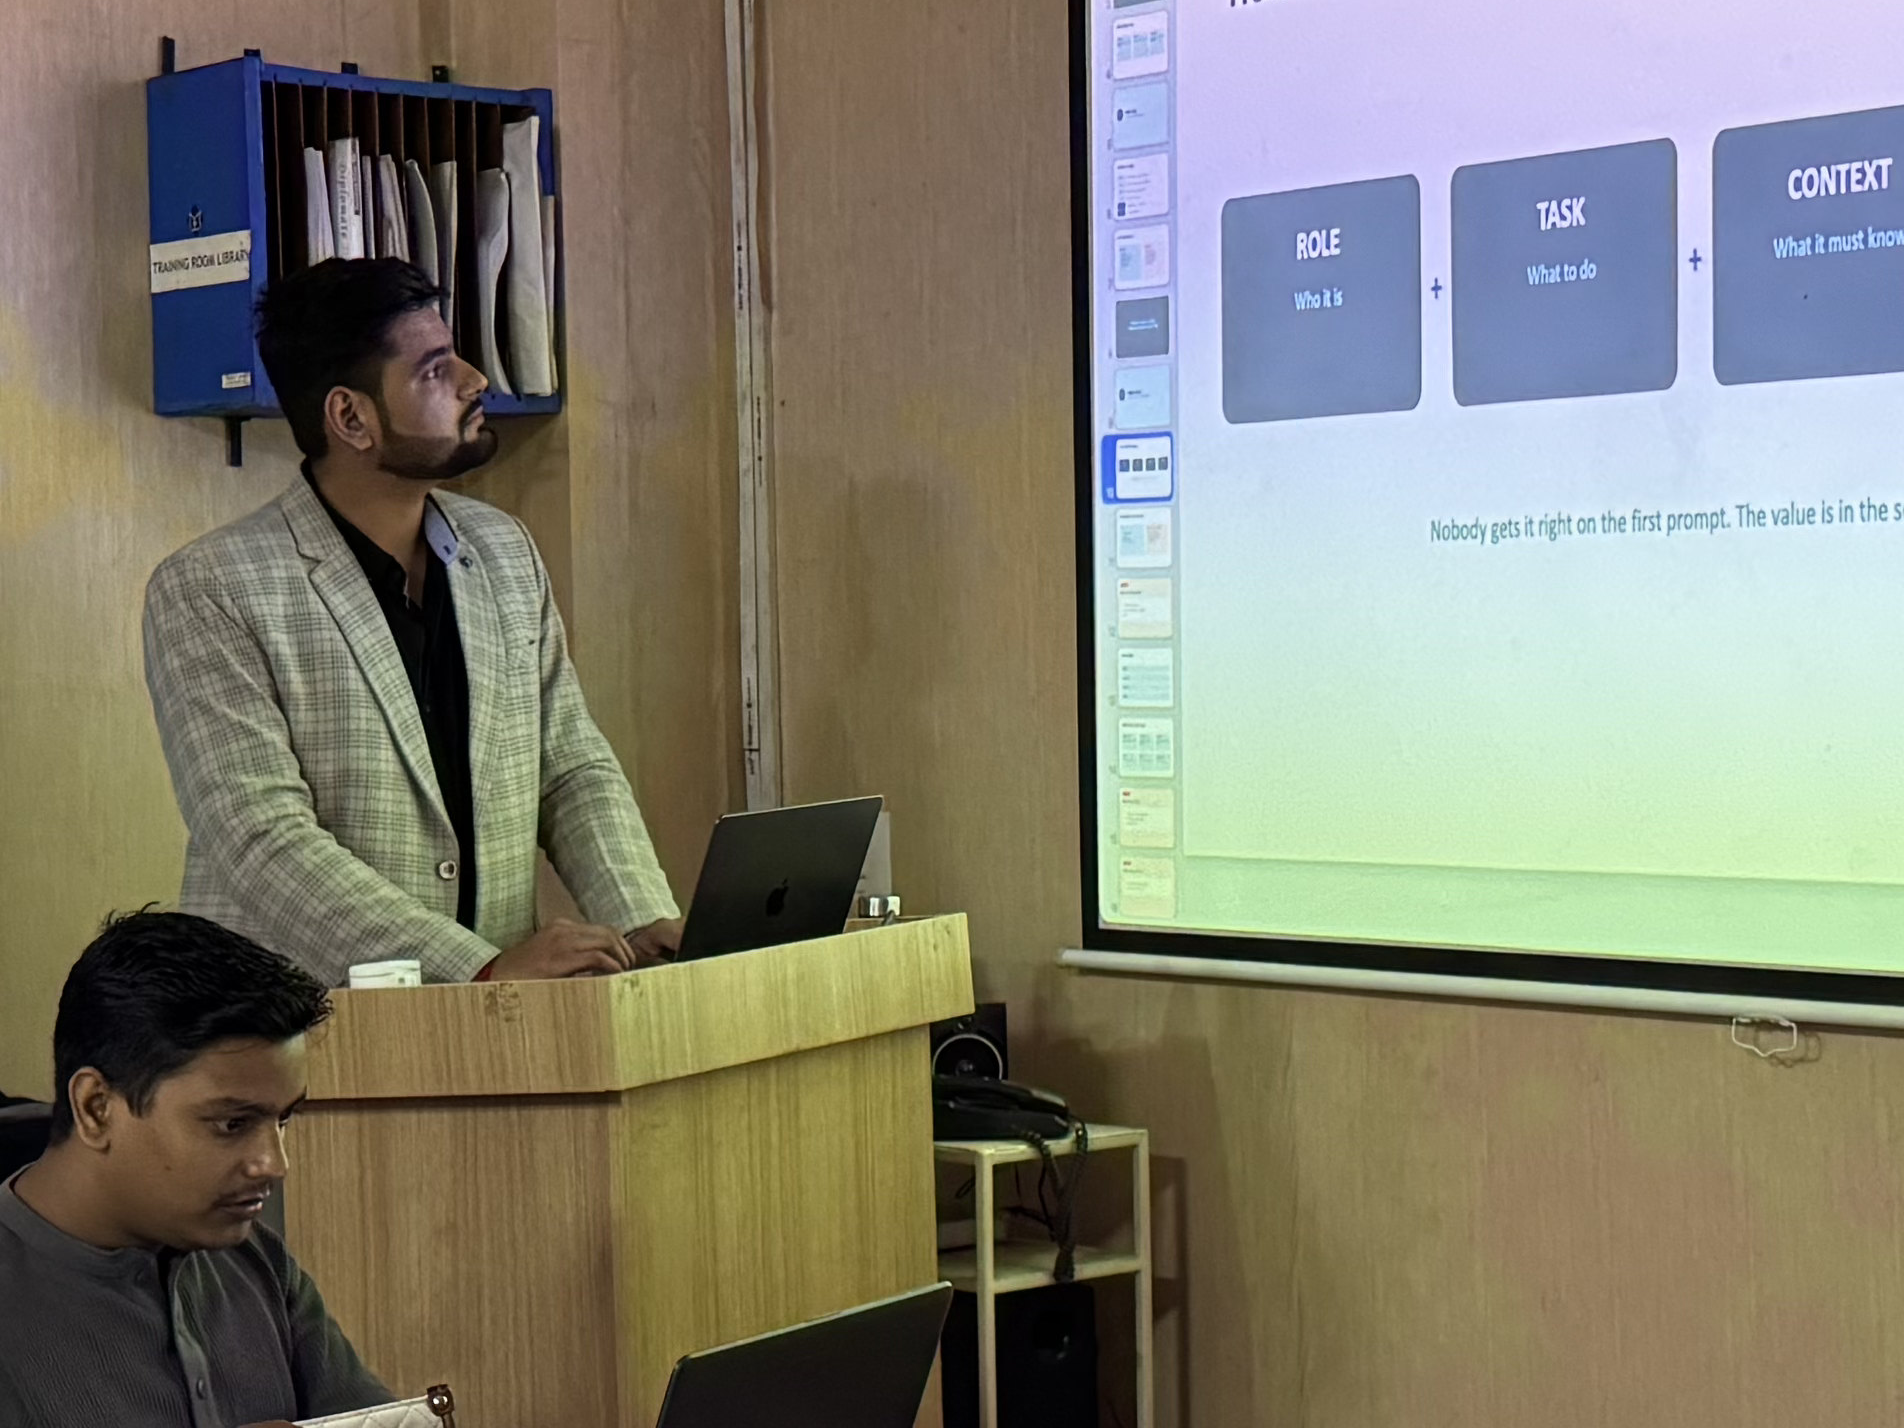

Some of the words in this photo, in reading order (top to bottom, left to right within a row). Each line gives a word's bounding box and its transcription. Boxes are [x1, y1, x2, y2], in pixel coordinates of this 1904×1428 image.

[1787, 157, 1893, 200] CONTEXT
[1536, 197, 1586, 232] TASK
[1295, 228, 1342, 260] ROLE
[1772, 232, 1812, 260] What
[1814, 232, 1826, 255] it
[1827, 227, 1865, 254] must
[152, 257, 190, 274] TRAINING
[191, 254, 216, 270] ROOM
[216, 248, 249, 267] LIBRARY
[1526, 263, 1561, 287] What
[1562, 262, 1577, 283] to
[1578, 259, 1598, 282] do
[1294, 288, 1322, 311] Who
[1322, 287, 1332, 309] it
[1333, 286, 1344, 308] is
[1430, 517, 1487, 545] Nobody
[1491, 516, 1521, 543] gets
[1523, 513, 1536, 539] it
[1538, 512, 1573, 542] right
[1576, 516, 1597, 535] on
[1600, 510, 1628, 534] the
[1631, 507, 1663, 533] first
[1665, 506, 1731, 537] prompt.
[1735, 502, 1767, 528] The
[1769, 501, 1817, 527] value
[1820, 498, 1835, 524] is
[1837, 498, 1856, 523] in
[1858, 496, 1890, 522] the
